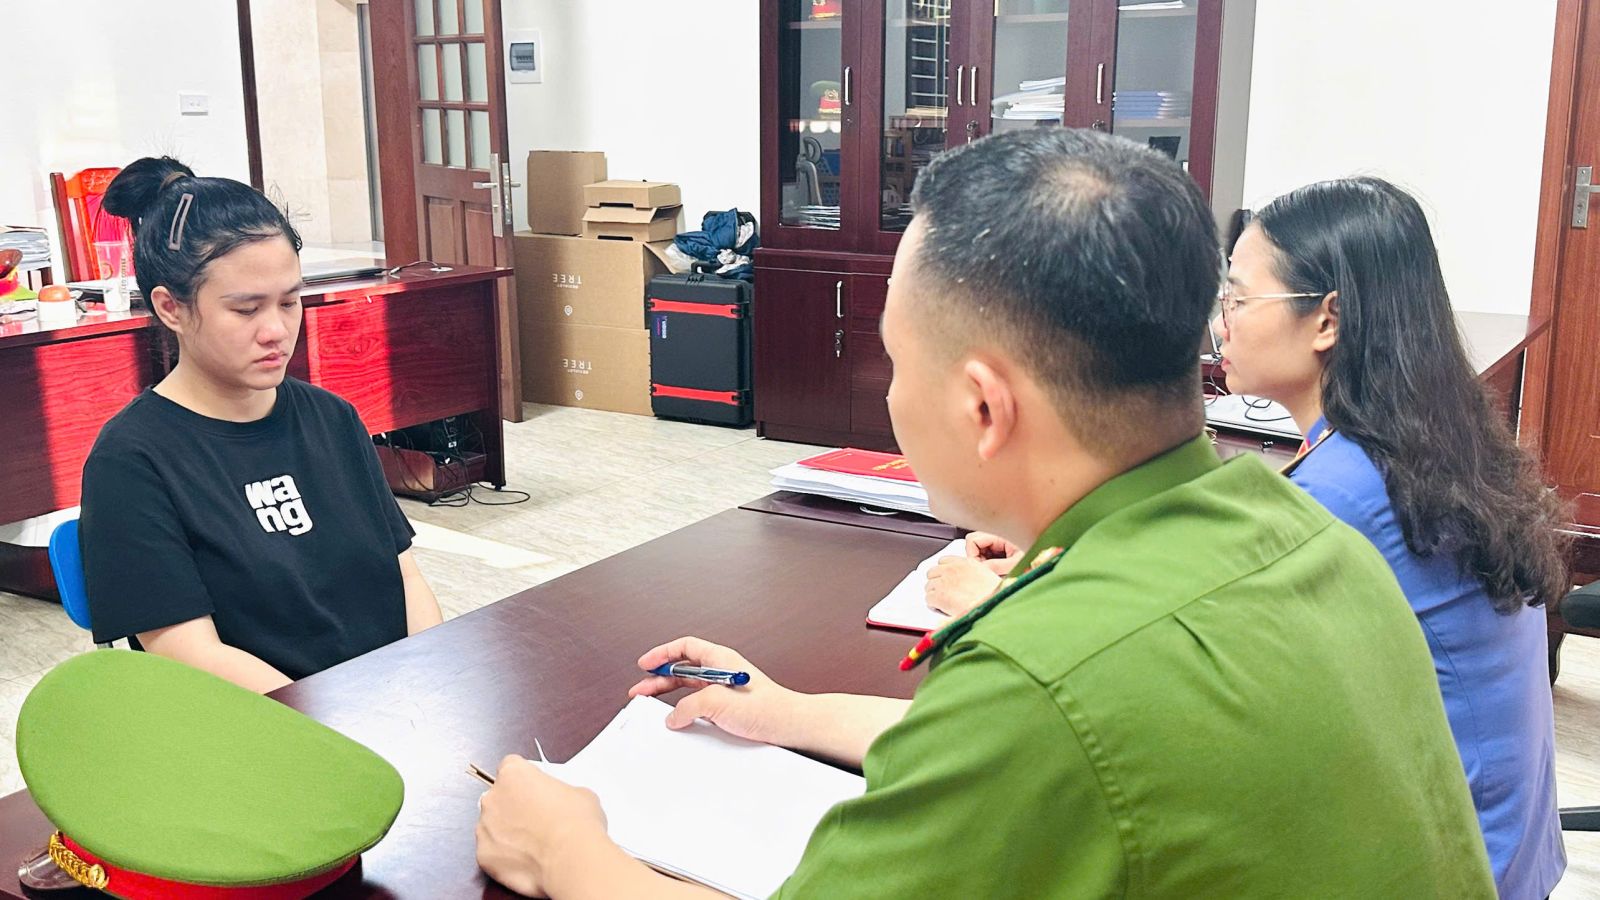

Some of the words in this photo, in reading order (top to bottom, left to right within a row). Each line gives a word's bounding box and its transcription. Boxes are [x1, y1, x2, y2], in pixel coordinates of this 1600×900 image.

[552, 273, 582, 285] TREE
[562, 358, 592, 370] TREE
[244, 474, 302, 510] wa
[255, 498, 313, 536] ng
